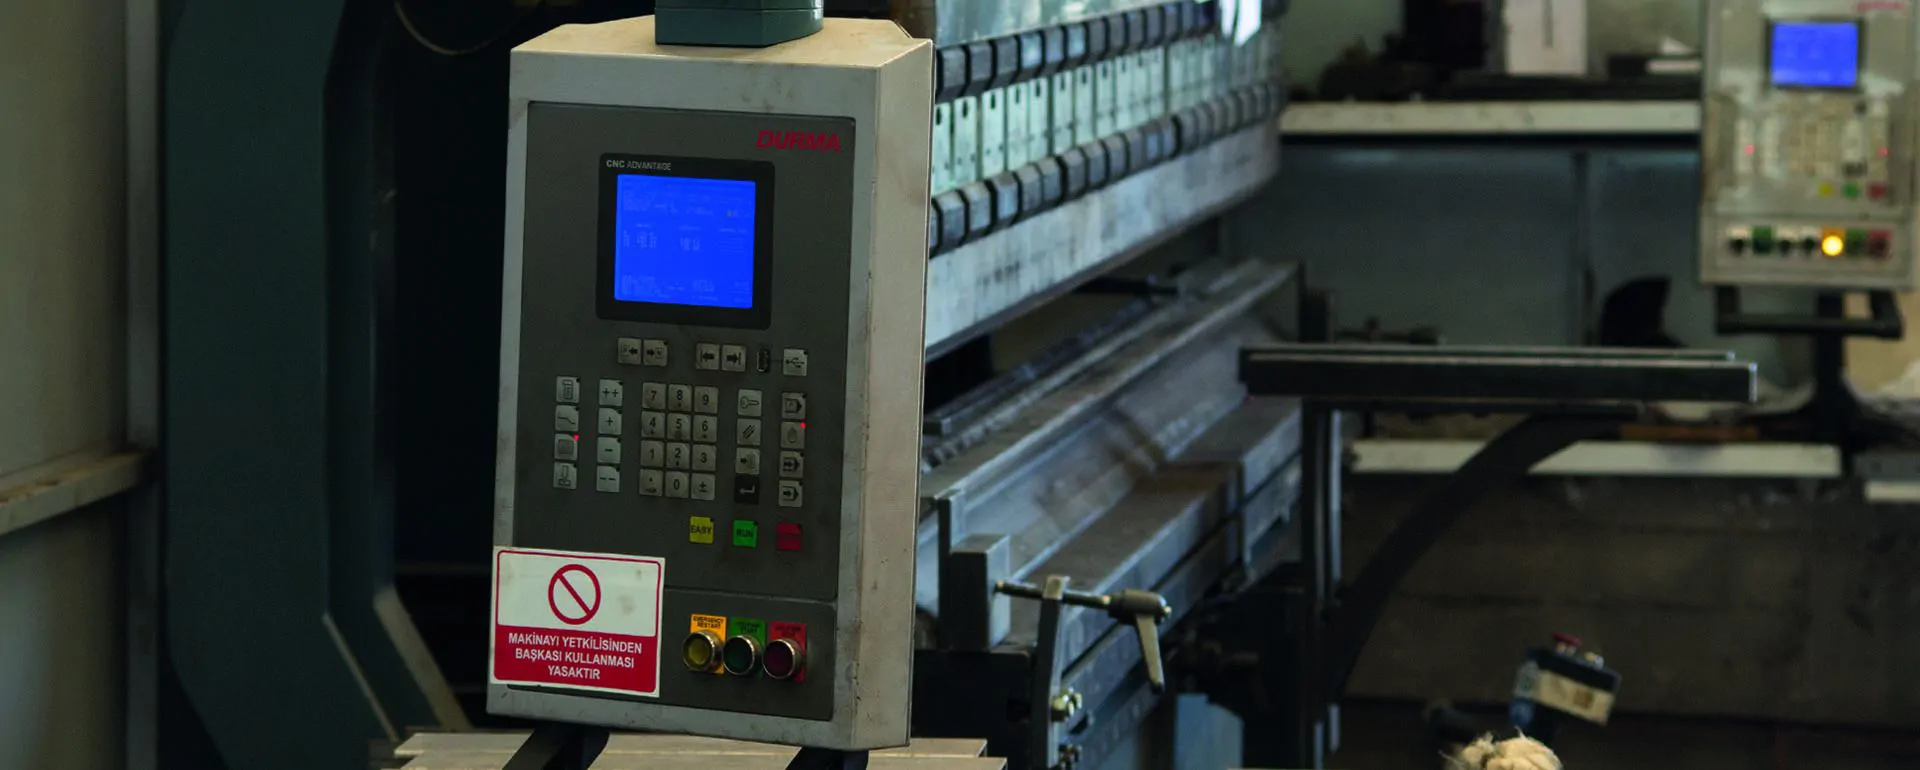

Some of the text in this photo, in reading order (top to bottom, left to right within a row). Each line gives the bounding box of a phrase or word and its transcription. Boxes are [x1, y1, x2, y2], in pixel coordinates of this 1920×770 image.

[757, 130, 841, 152] DURMA
[606, 160, 672, 171] CNC ADVANTAGE
[650, 389, 709, 406] 7 8 9
[649, 417, 709, 431] 4 5 6
[649, 448, 707, 463] 1 2 3
[673, 479, 680, 490] 0
[690, 525, 712, 535] EASY
[736, 529, 754, 539] RUN
[697, 621, 721, 630] RESTART
[508, 632, 642, 654] MAKİNAYI YETKİLİSİNDEN
[515, 648, 635, 669] BAŞKASI KULLANMASI
[548, 665, 601, 680] YASAKTIR
